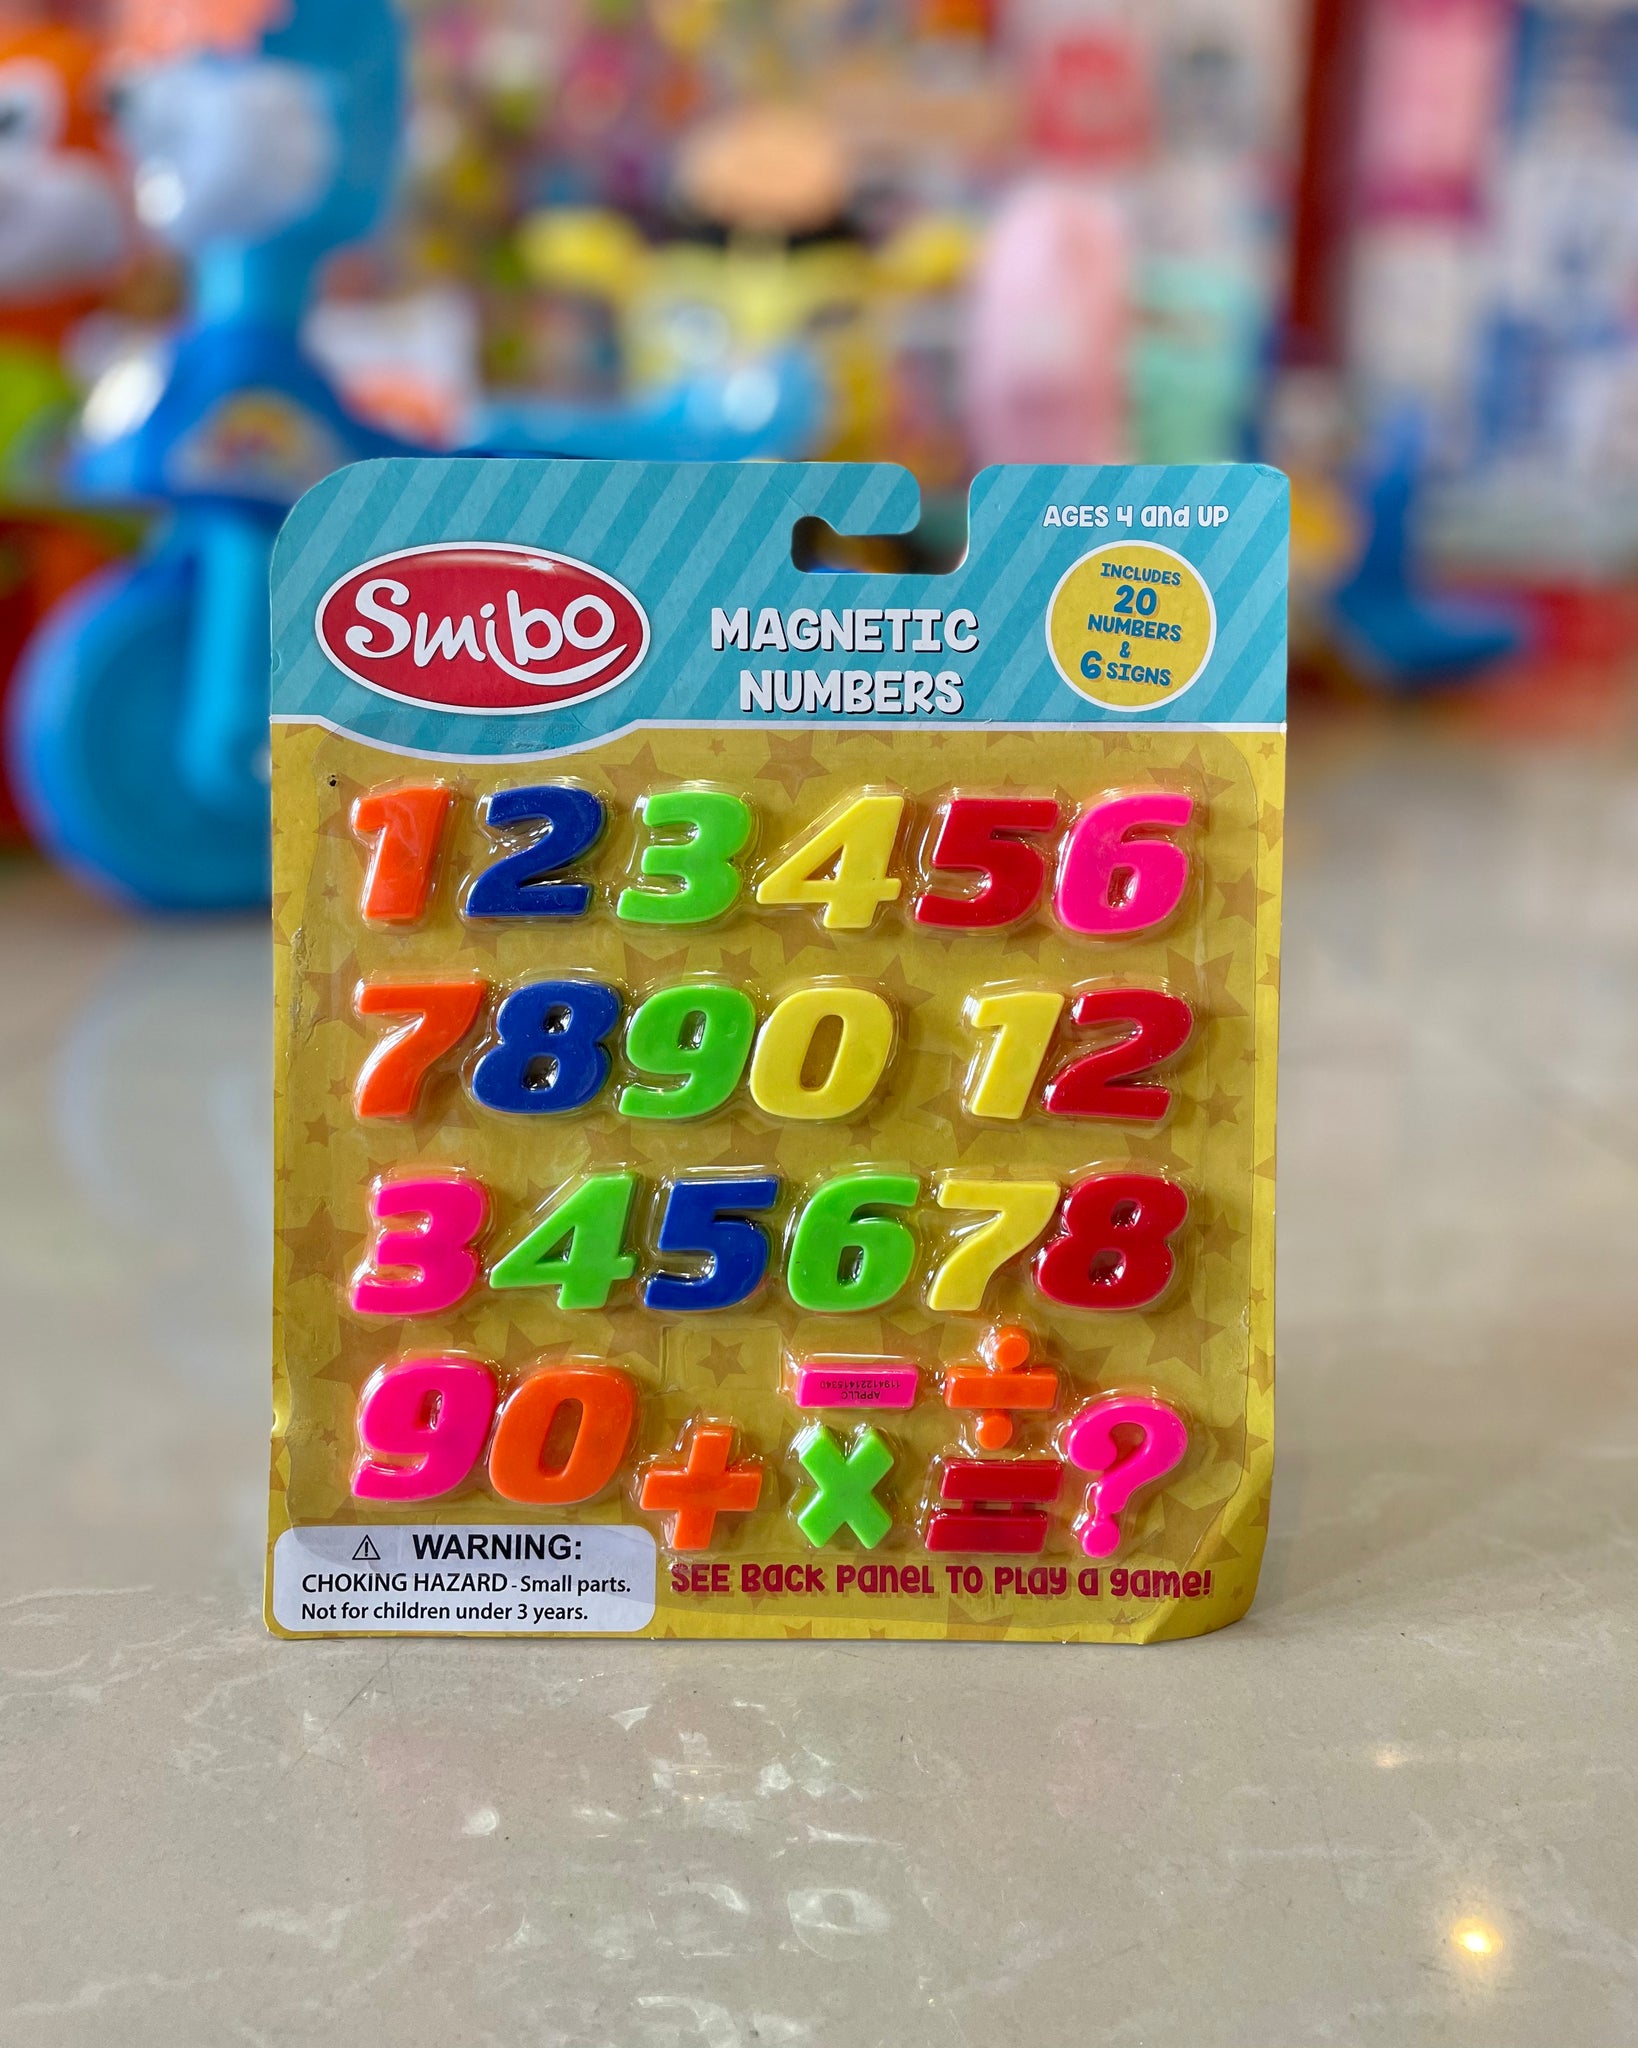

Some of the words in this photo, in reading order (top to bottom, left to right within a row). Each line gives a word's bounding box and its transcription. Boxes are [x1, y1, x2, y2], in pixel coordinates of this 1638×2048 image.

[1043, 505, 1109, 527] AGES
[1117, 505, 1133, 527] 4
[1198, 505, 1229, 527] UP
[1100, 563, 1181, 585] INCLUDES
[1114, 585, 1157, 615] 20
[346, 578, 628, 686] Smibo
[711, 607, 979, 652] MAGNETIC
[1088, 614, 1182, 642] NUMBERS
[1119, 641, 1130, 658] &
[1080, 650, 1102, 679] 6
[1106, 662, 1171, 686] SIGNS
[740, 670, 964, 714] NUMBERS
[354, 787, 454, 919] 1
[465, 786, 605, 918] 2
[616, 791, 752, 924] 3
[756, 794, 905, 929] 4
[913, 797, 1060, 928] 5
[1054, 793, 1194, 934] 6
[355, 981, 489, 1117] 7
[472, 981, 621, 1115] 8
[617, 985, 756, 1119] 9
[749, 987, 894, 1119] 0
[969, 993, 1065, 1119] 1
[1041, 988, 1194, 1119] 2
[351, 1177, 489, 1313] 3
[489, 1171, 642, 1309] 4
[644, 1177, 782, 1310] 5
[788, 1173, 920, 1312] 6
[927, 1180, 1060, 1310] 7
[1034, 1174, 1190, 1310] 8
[351, 1357, 498, 1502] 9
[489, 1365, 636, 1504] 0
[413, 1534, 582, 1560] WARNING:
[302, 1573, 407, 1592] CHOKING
[414, 1573, 507, 1592] HAZARD
[520, 1575, 572, 1592] Small
[578, 1578, 631, 1596] parts.
[671, 1564, 730, 1592] SEE
[946, 1566, 983, 1593] TO
[302, 1603, 336, 1620] Not
[341, 1602, 368, 1619] for
[373, 1602, 450, 1619] children
[456, 1604, 512, 1620] under
[518, 1604, 527, 1619] 3
[534, 1606, 588, 1624] years.
